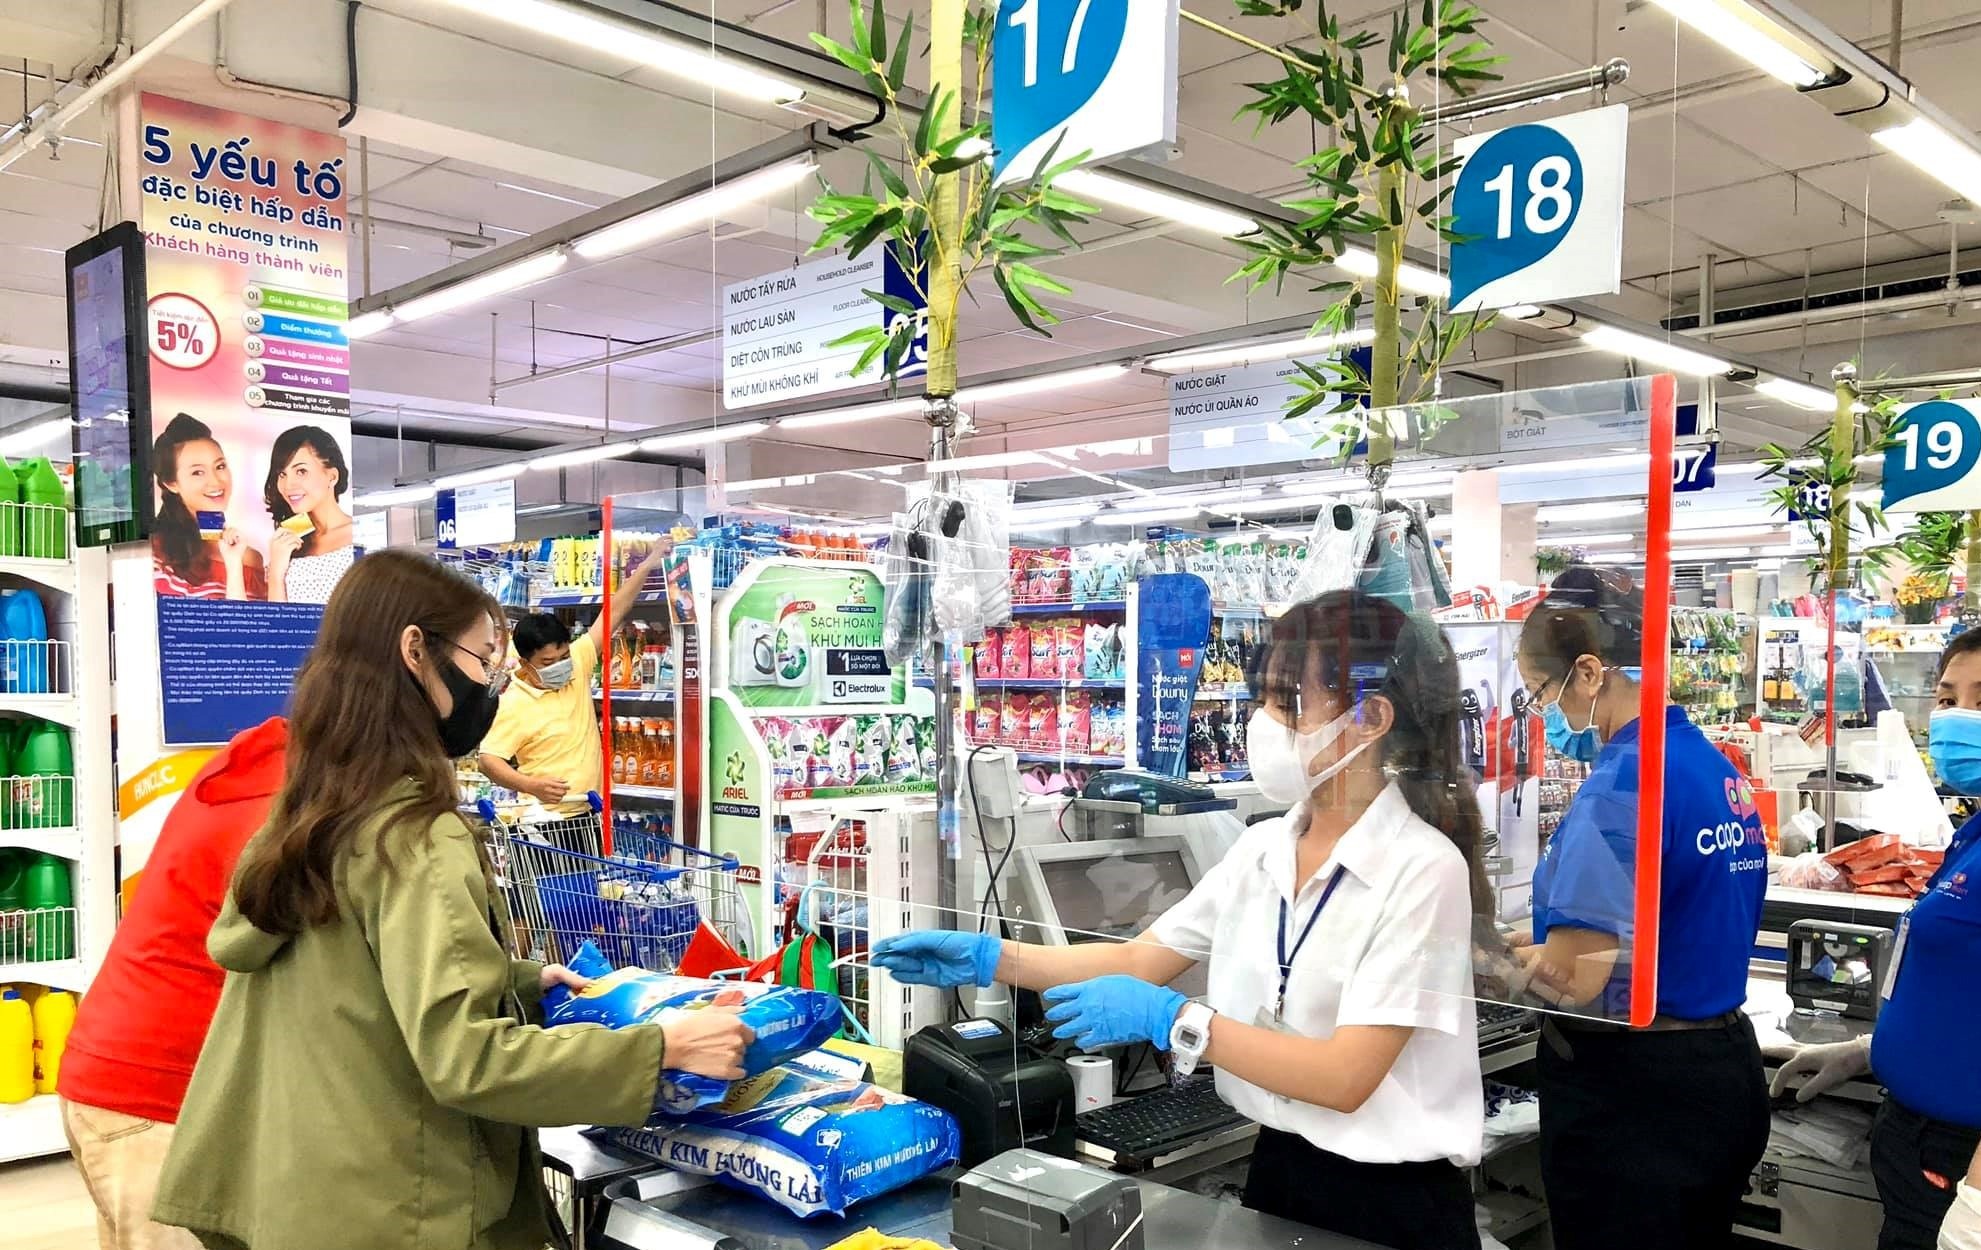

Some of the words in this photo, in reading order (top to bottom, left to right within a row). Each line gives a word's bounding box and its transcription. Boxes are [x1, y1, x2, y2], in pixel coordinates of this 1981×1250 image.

[1008, 0, 1092, 88] 17
[144, 126, 171, 164] 5
[190, 138, 276, 187] yếu
[294, 158, 343, 200] tố
[142, 176, 187, 202] đặc
[196, 185, 243, 213] biệt
[251, 196, 294, 223] hấp
[302, 205, 342, 231] dẫn
[1484, 155, 1573, 240] 18
[170, 213, 202, 230] của
[208, 222, 274, 246] chương
[280, 234, 319, 253] trình
[144, 231, 199, 253] Khách
[206, 242, 249, 264] hàng
[256, 252, 304, 272] thành
[309, 263, 343, 279] viên
[817, 268, 846, 281] HOUSEHOLD
[847, 261, 873, 274] CLEANSER
[248, 291, 258, 301] 01
[833, 302, 849, 313] FLOOR
[247, 316, 260, 326] 02
[758, 315, 775, 329] LAU
[157, 320, 203, 355] 5%
[247, 342, 261, 351] 03
[247, 368, 261, 377] 04
[1175, 377, 1202, 391] NƯỚC
[249, 391, 261, 400] 05
[1175, 403, 1202, 416] NƯỚC
[1895, 421, 1963, 471] 19
[439, 519, 456, 543] 06
[1456, 648, 1488, 661] Energizer
[848, 683, 886, 693] Electrolux
[1152, 686, 1188, 703] Downy
[722, 787, 749, 799] ARIEL
[847, 1161, 872, 1181] THIÊN
[875, 1154, 891, 1170] KIM
[894, 1141, 923, 1165] HƯƠNG
[671, 1140, 709, 1169] KIM
[715, 1150, 782, 1191] HƯƠNG
[787, 1172, 824, 1204] LÀI
